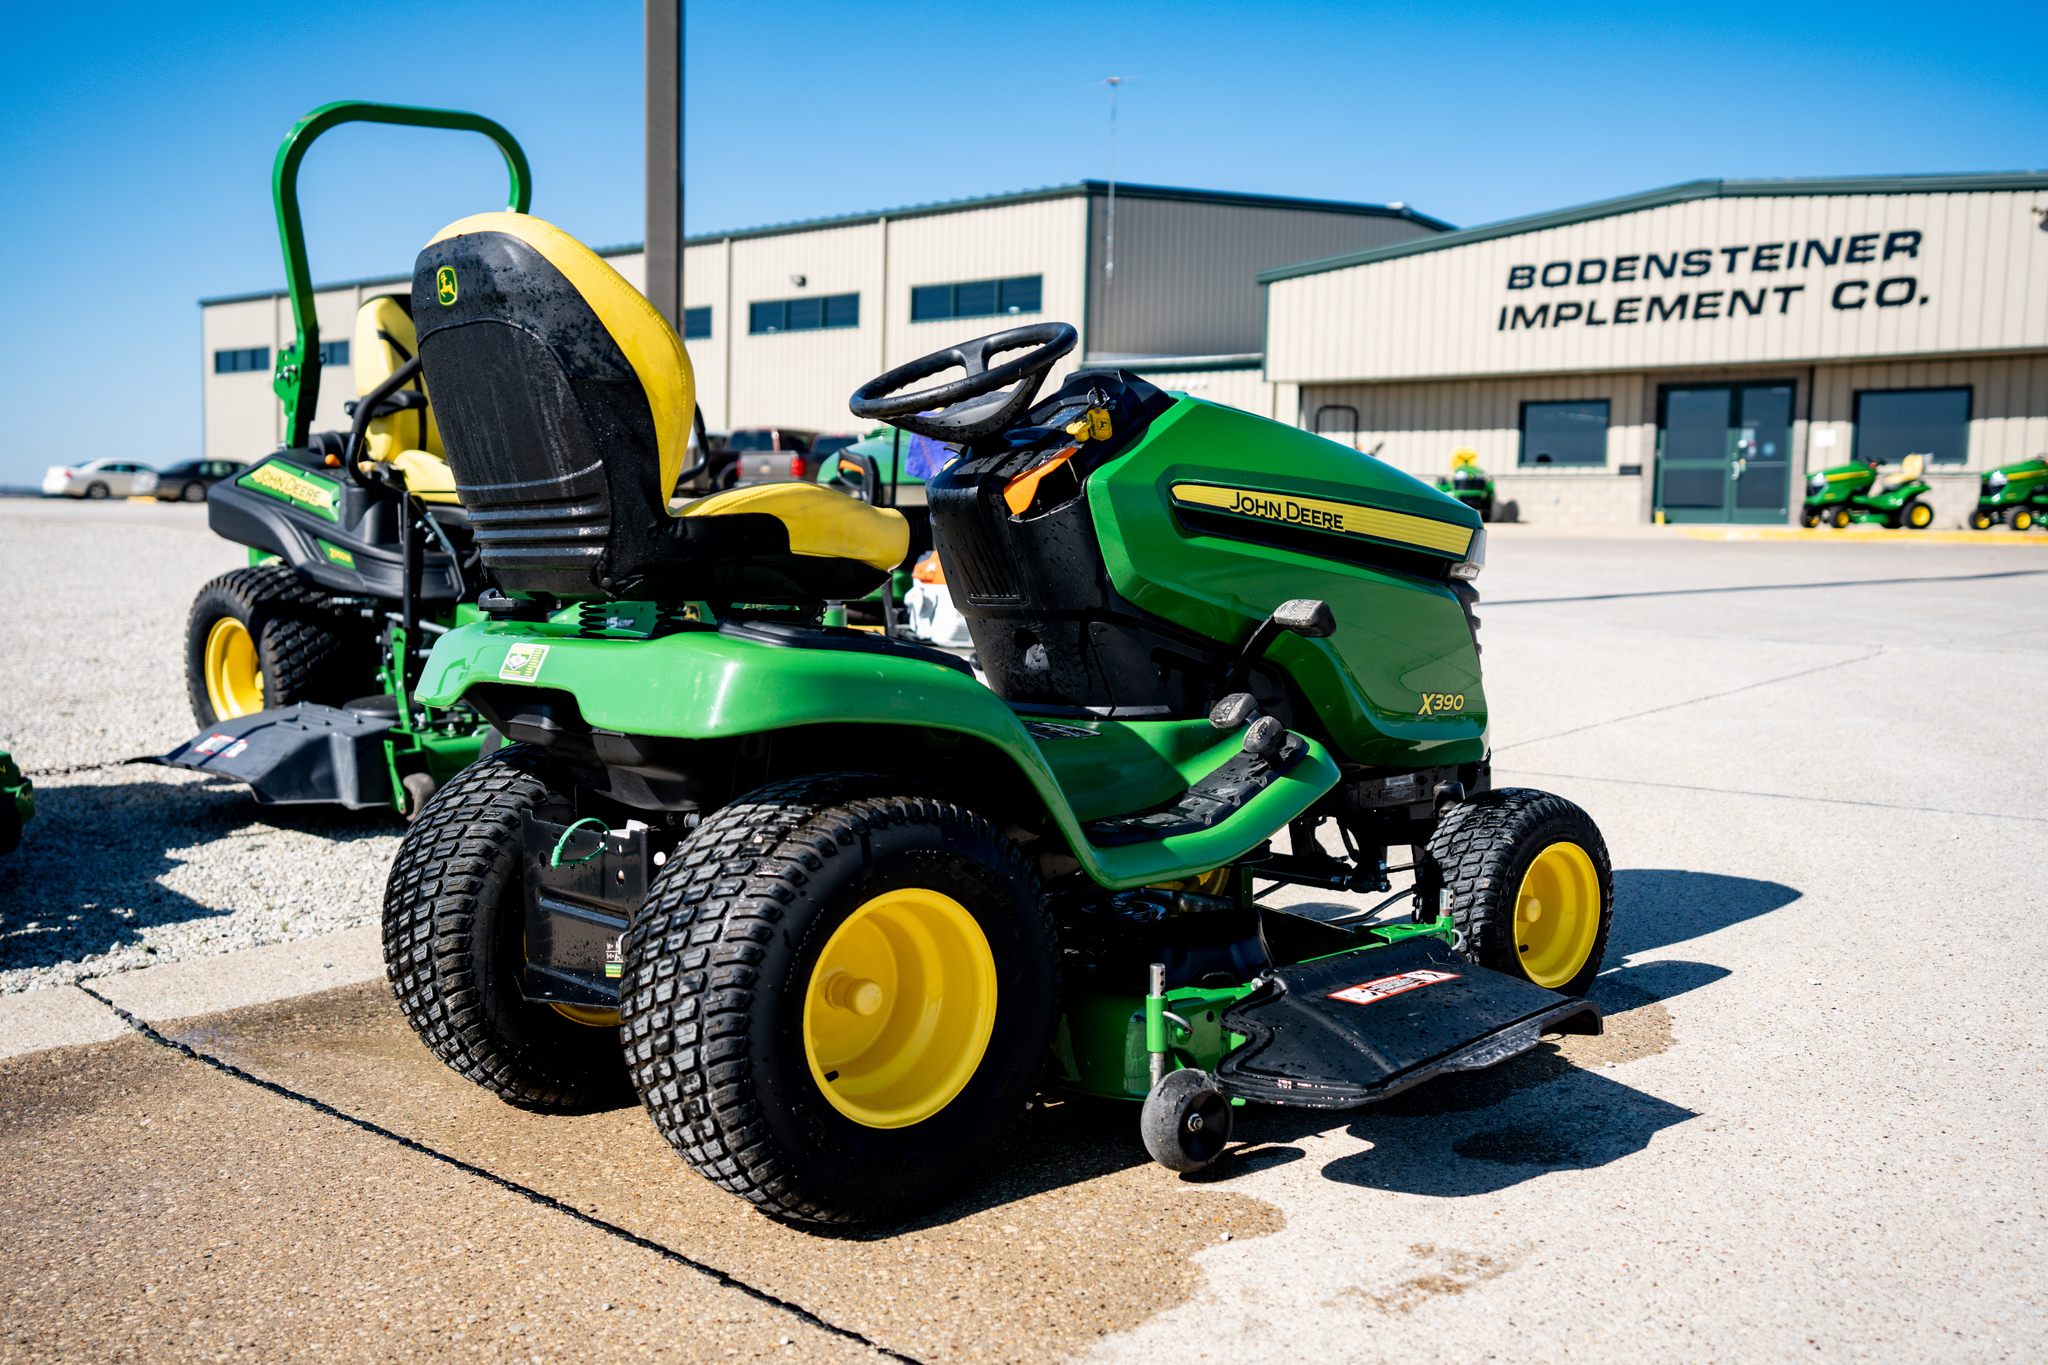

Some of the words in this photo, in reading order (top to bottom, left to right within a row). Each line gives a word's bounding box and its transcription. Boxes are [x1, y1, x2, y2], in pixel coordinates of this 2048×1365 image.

[1507, 230, 1922, 290] BODENSTEINER
[1498, 285, 1805, 331] IMPLEMENT
[1832, 277, 1929, 311] CO.
[256, 466, 286, 488] JOHN
[285, 477, 322, 503] DEERE
[1229, 492, 1281, 518] JOHN
[1286, 501, 1344, 530] DEERE
[1416, 691, 1465, 716] X390
